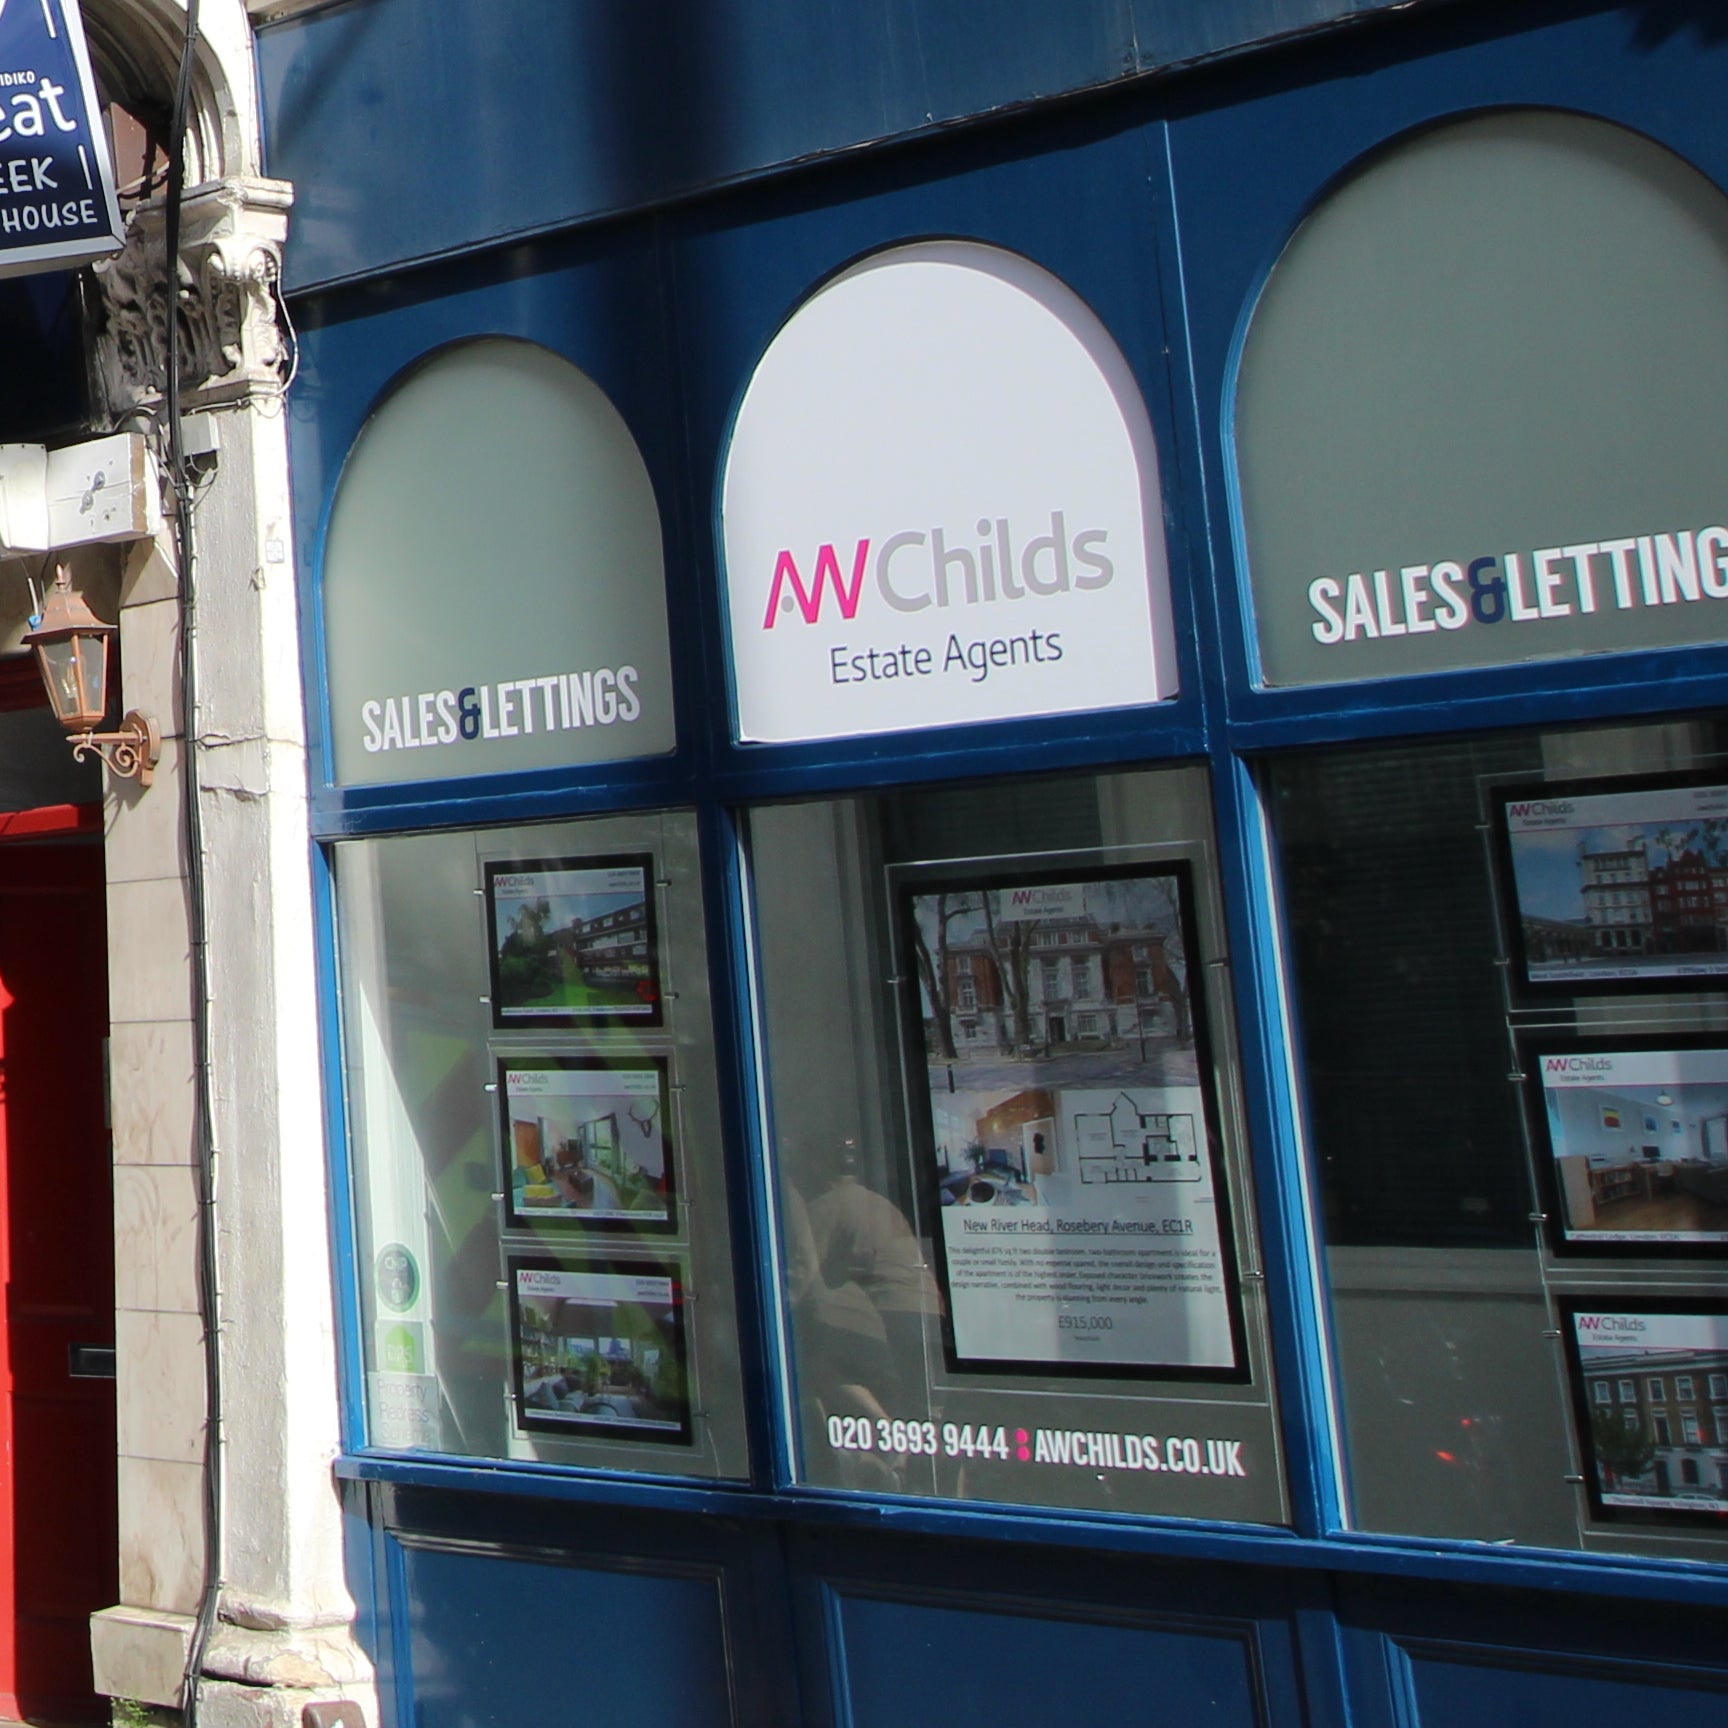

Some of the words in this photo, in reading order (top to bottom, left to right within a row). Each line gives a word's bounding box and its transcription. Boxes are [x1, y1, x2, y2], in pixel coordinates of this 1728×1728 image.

[2, 199, 99, 234] HOUSE
[830, 644, 933, 685] Estate
[942, 628, 1064, 683] Agents
[964, 1219, 987, 1232] New
[991, 1219, 1018, 1232] River
[1021, 1219, 1054, 1234] Head,
[1056, 1219, 1109, 1235] Rosebery
[1112, 1220, 1159, 1234] Avenue,
[1162, 1219, 1193, 1233] EC1R
[828, 1416, 873, 1450] 020
[876, 1419, 938, 1454] 3693
[943, 1423, 1010, 1460] 9444
[1035, 1428, 1246, 1476] AWCHILDS.CO.UK
